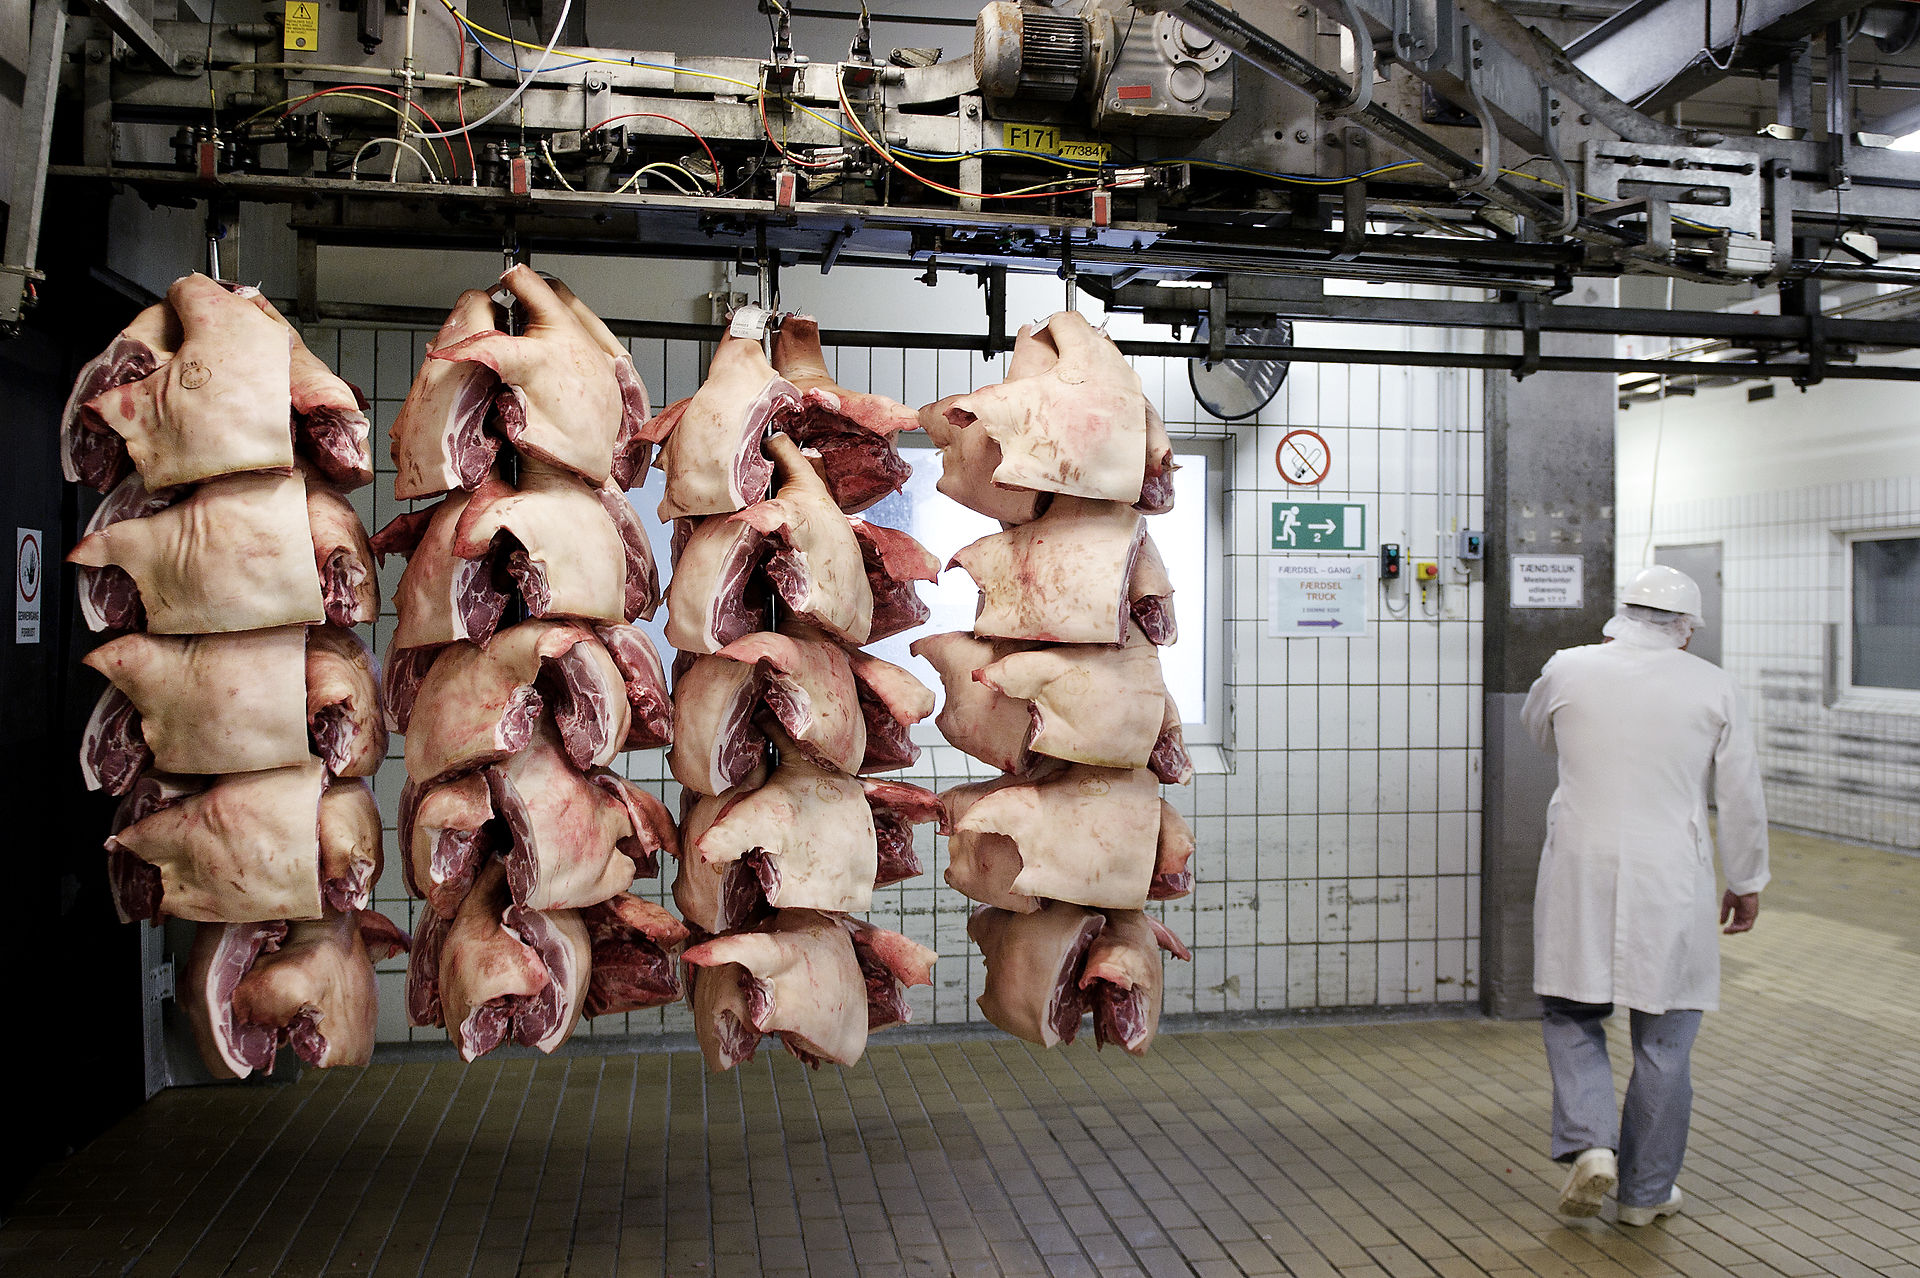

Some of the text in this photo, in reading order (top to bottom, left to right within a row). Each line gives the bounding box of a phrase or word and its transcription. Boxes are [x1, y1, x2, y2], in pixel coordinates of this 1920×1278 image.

[1010, 127, 1054, 149] F171
[1065, 145, 1106, 157] 773847
[1313, 533, 1321, 542] 2
[1278, 566, 1318, 574] FÆRDSEL
[1327, 566, 1351, 574] GANG
[1300, 581, 1343, 590] FÆRDSEL
[1306, 592, 1337, 601] TRUCK
